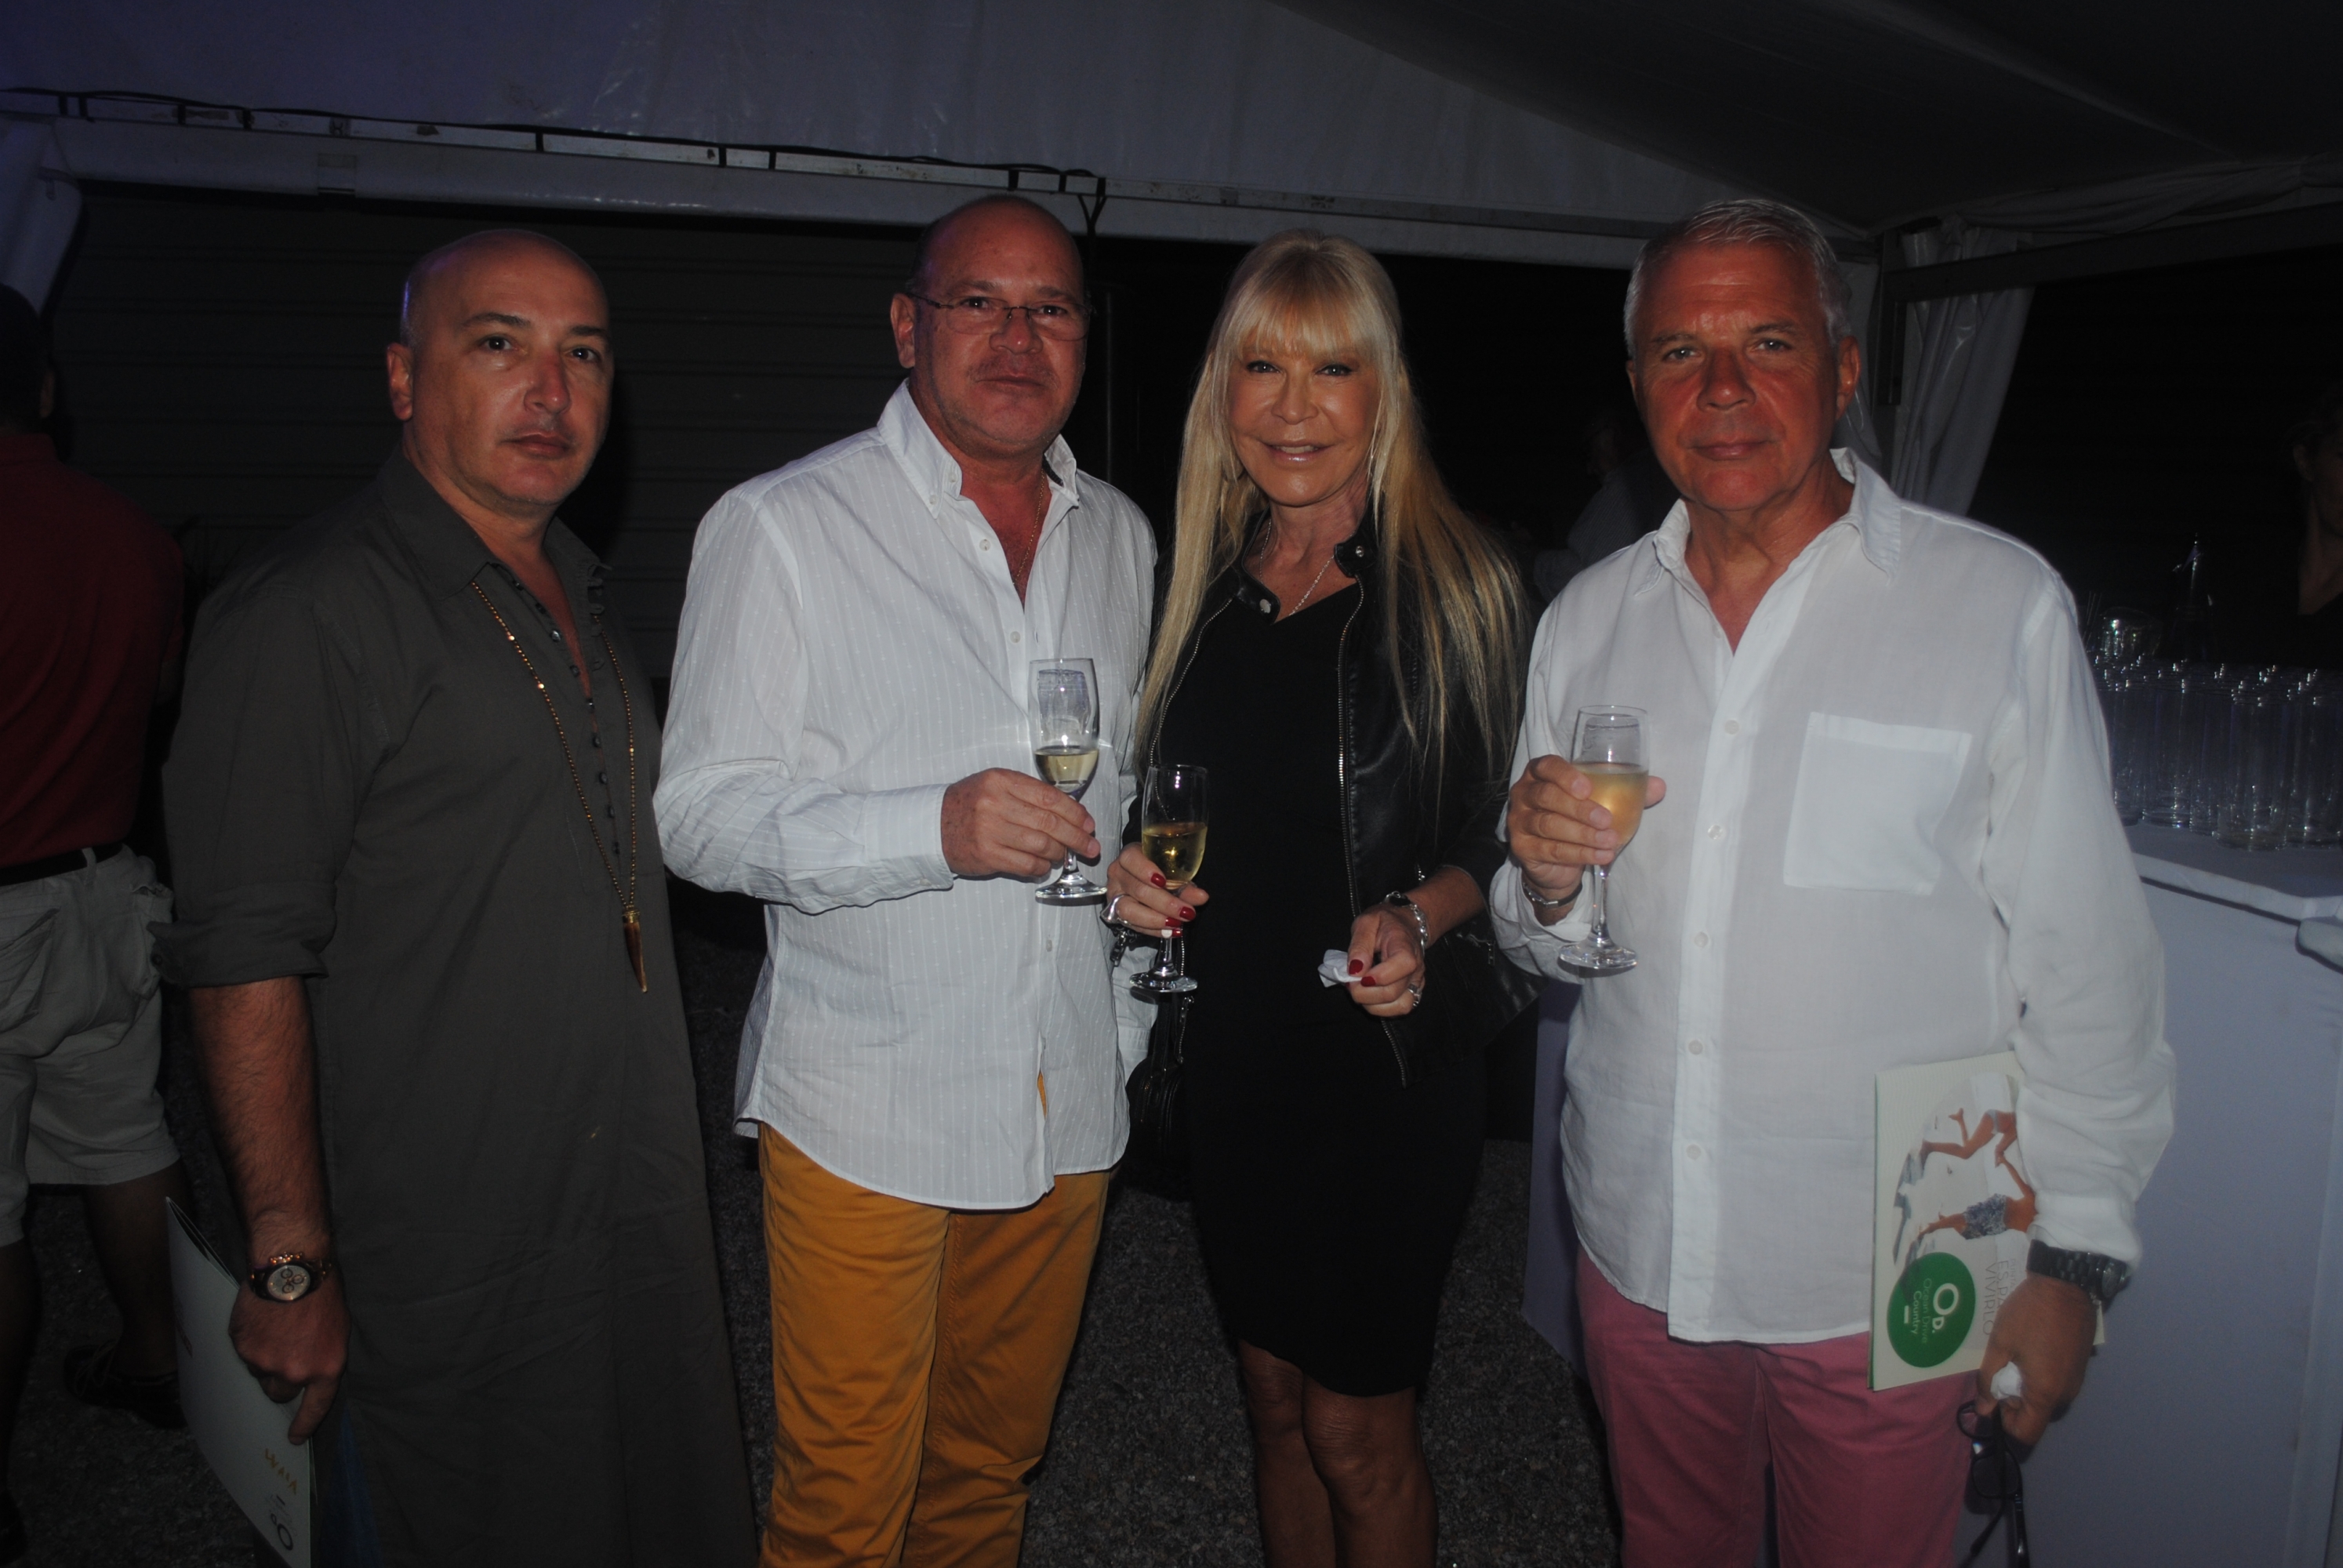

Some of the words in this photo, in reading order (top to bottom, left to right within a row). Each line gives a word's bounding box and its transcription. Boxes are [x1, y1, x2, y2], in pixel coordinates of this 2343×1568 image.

[1911, 1290, 1922, 1335] Country
[1923, 1278, 1933, 1313] Ocean
[1983, 1262, 1997, 1335] VIVIRLO
[1996, 1286, 2009, 1308] PA
[1921, 1316, 1931, 1344] Drive
